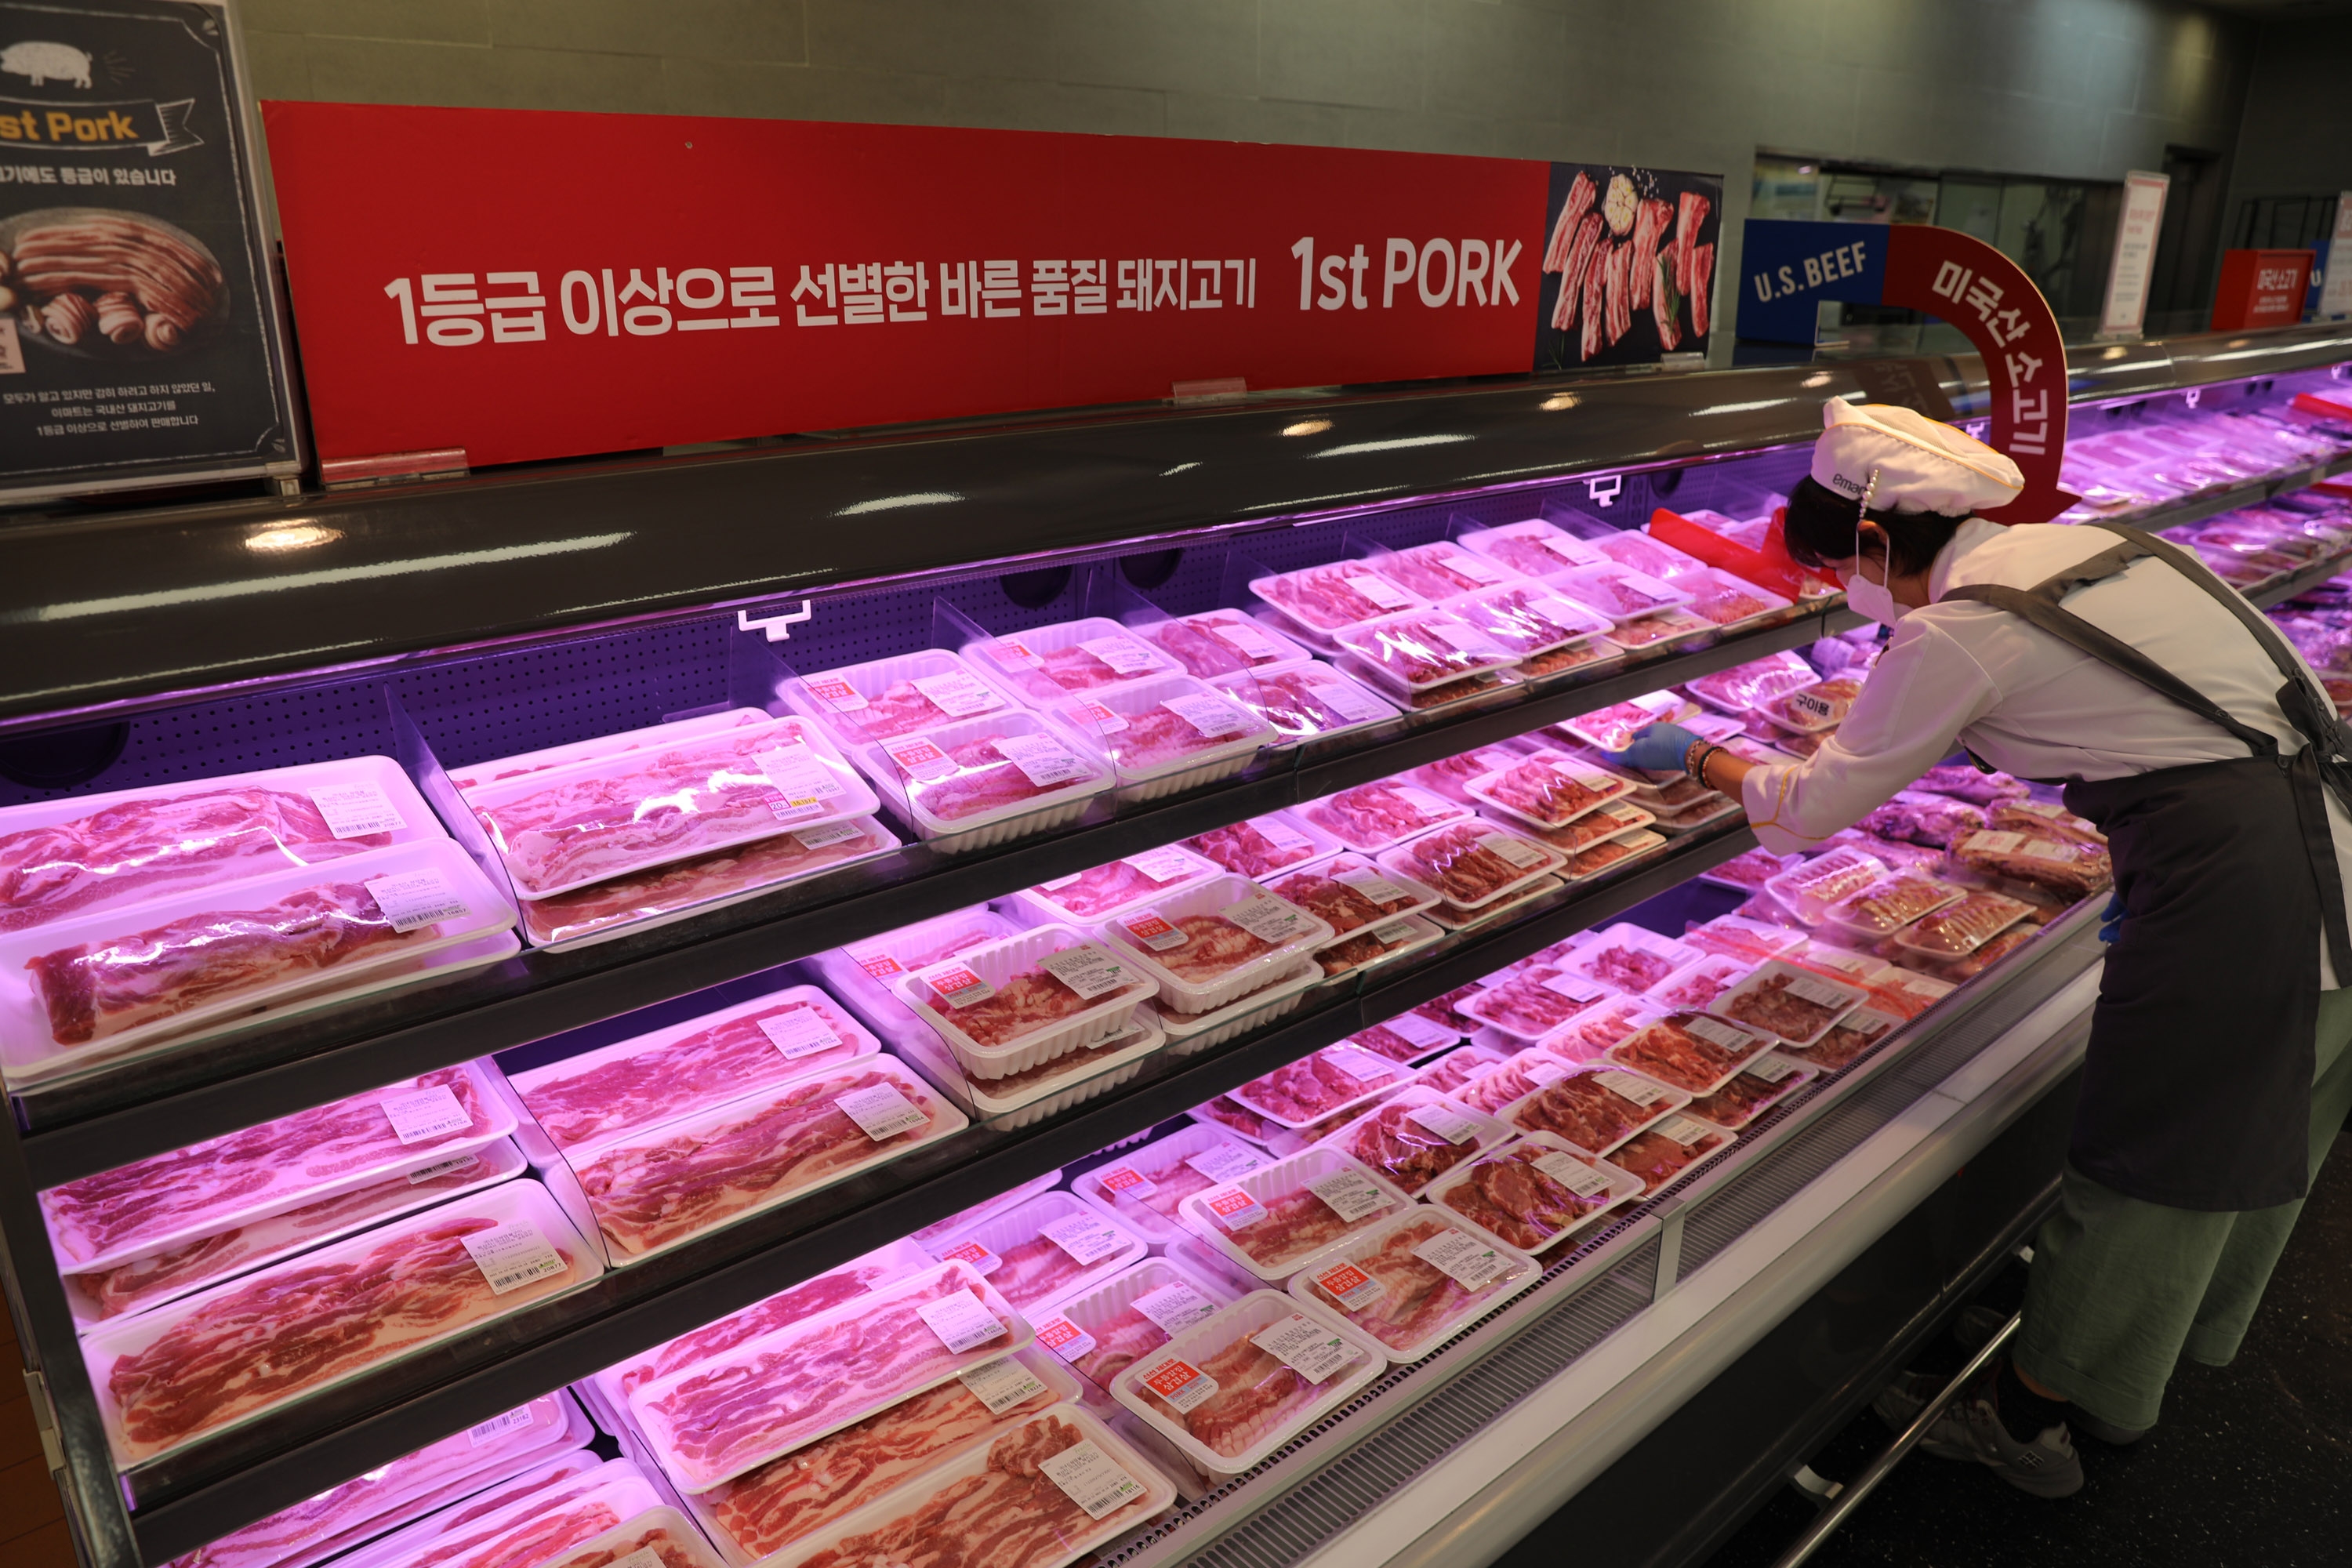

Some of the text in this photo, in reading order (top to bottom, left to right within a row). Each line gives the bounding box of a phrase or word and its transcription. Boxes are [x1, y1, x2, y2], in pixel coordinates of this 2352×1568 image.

[45, 111, 140, 142] Pork
[60, 167, 110, 185] 등급이
[113, 168, 176, 187] 있습니다
[1290, 237, 1523, 310] 1st PORK
[383, 258, 1256, 347] 1등급 이상으로 선별한 바른 품질 돼지고기
[1932, 260, 2049, 456] 미국산 소고기
[118, 385, 147, 397] 하려고
[150, 384, 169, 395] 하지
[171, 383, 200, 394] 않았던
[51, 401, 176, 418] 이마트는 국내산 돼지고기를
[37, 415, 198, 436] 1등급 이상으로 선별하여 판매합니다
[1832, 474, 1867, 495] emar
[1796, 693, 1829, 717] 구이용
[543, 1263, 561, 1272] 20877
